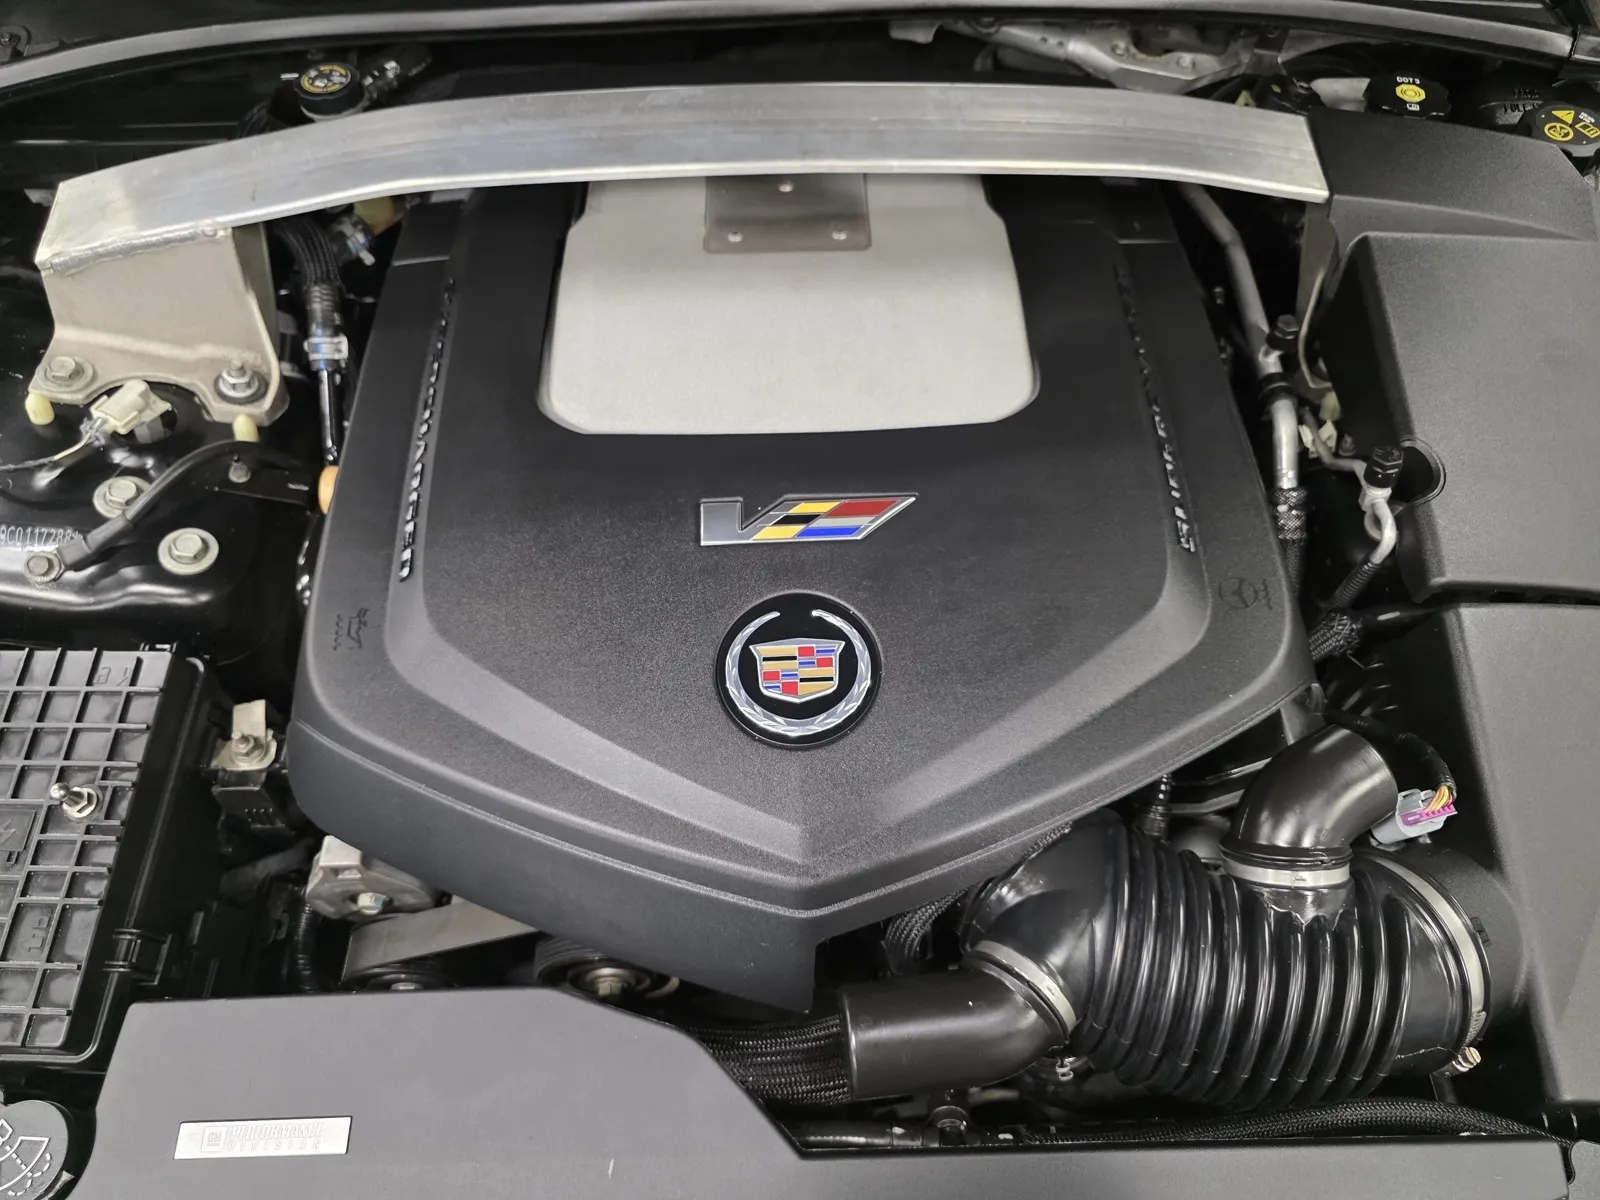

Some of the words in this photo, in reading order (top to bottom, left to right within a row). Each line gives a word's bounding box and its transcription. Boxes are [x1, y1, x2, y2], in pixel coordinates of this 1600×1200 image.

[207, 1131, 222, 1143] GM
[232, 1122, 324, 1140] PERFORMANCE
[229, 1137, 321, 1152] DIVISION
